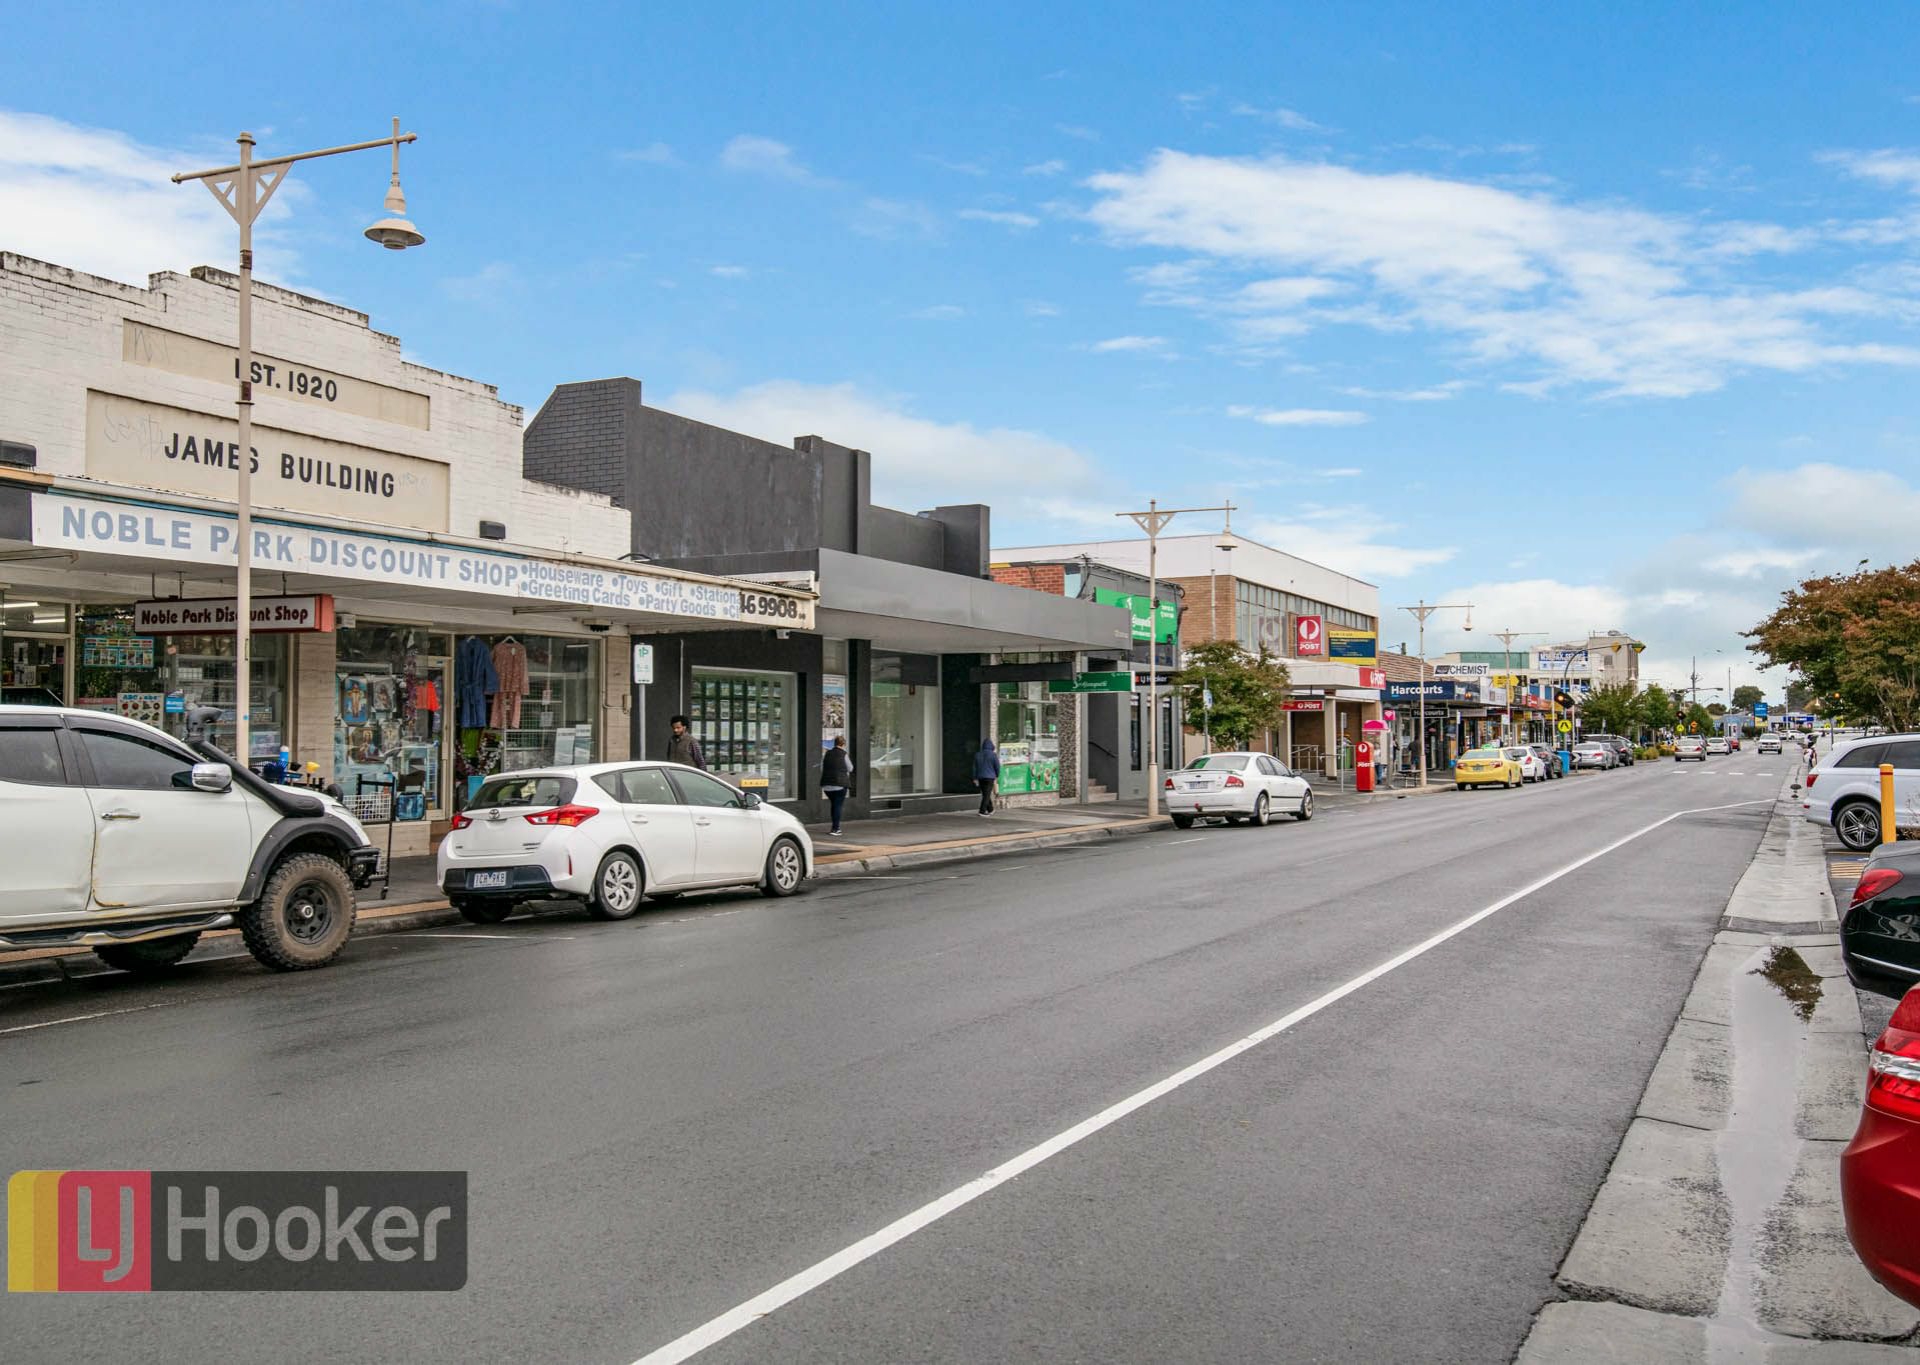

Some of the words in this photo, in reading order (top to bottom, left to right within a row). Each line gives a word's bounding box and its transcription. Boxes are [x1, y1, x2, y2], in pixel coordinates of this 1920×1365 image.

[288, 370, 338, 402] 1920
[164, 432, 259, 474] JAMES
[281, 453, 395, 498] BUILDING
[62, 506, 192, 550] NOBLE
[310, 537, 450, 579] DISCOUNT
[459, 559, 518, 587] SHOP
[528, 561, 604, 588] Houseware
[618, 574, 648, 594] Toys
[661, 581, 683, 598] Gift
[528, 579, 590, 604] Greeting
[592, 587, 630, 607] Cards
[646, 593, 677, 616] Party
[680, 599, 716, 617] Goods
[758, 596, 797, 619] 9908
[141, 609, 178, 625] Noble
[182, 608, 211, 623] Park
[215, 606, 270, 623] Disunt
[275, 606, 308, 624] Shop
[1450, 665, 1488, 675] CHEMIST
[1391, 685, 1443, 695] Harcourts
